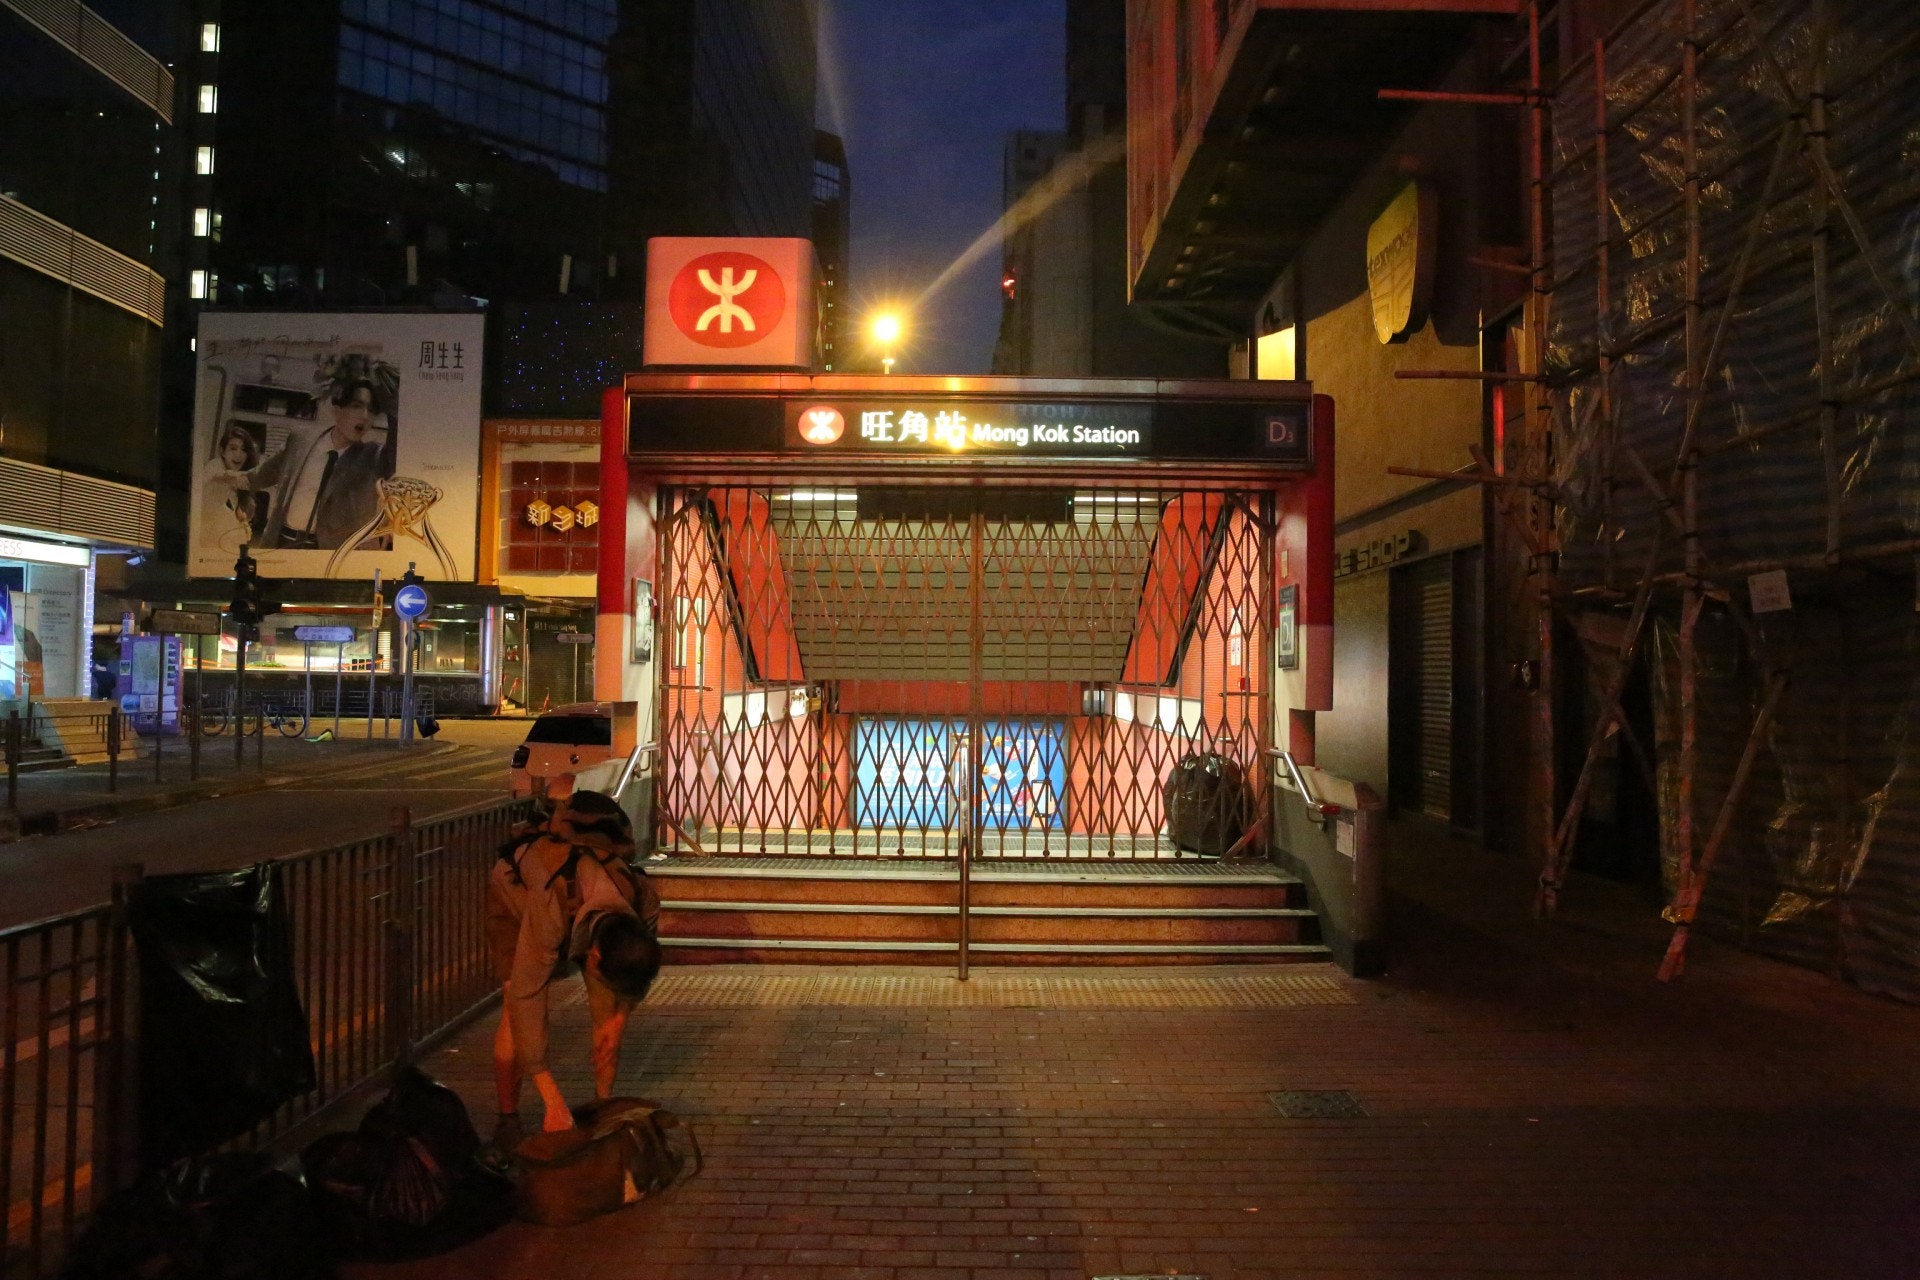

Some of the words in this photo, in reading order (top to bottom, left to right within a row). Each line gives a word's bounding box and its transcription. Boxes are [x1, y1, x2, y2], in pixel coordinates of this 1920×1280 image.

[419, 341, 464, 368] 周生生
[861, 410, 966, 443] 旺角站
[974, 424, 1028, 447] Mong
[1033, 424, 1069, 442] Kok
[1073, 426, 1139, 443] Station
[527, 500, 599, 532] 新之城
[1356, 530, 1409, 571] SHOP
